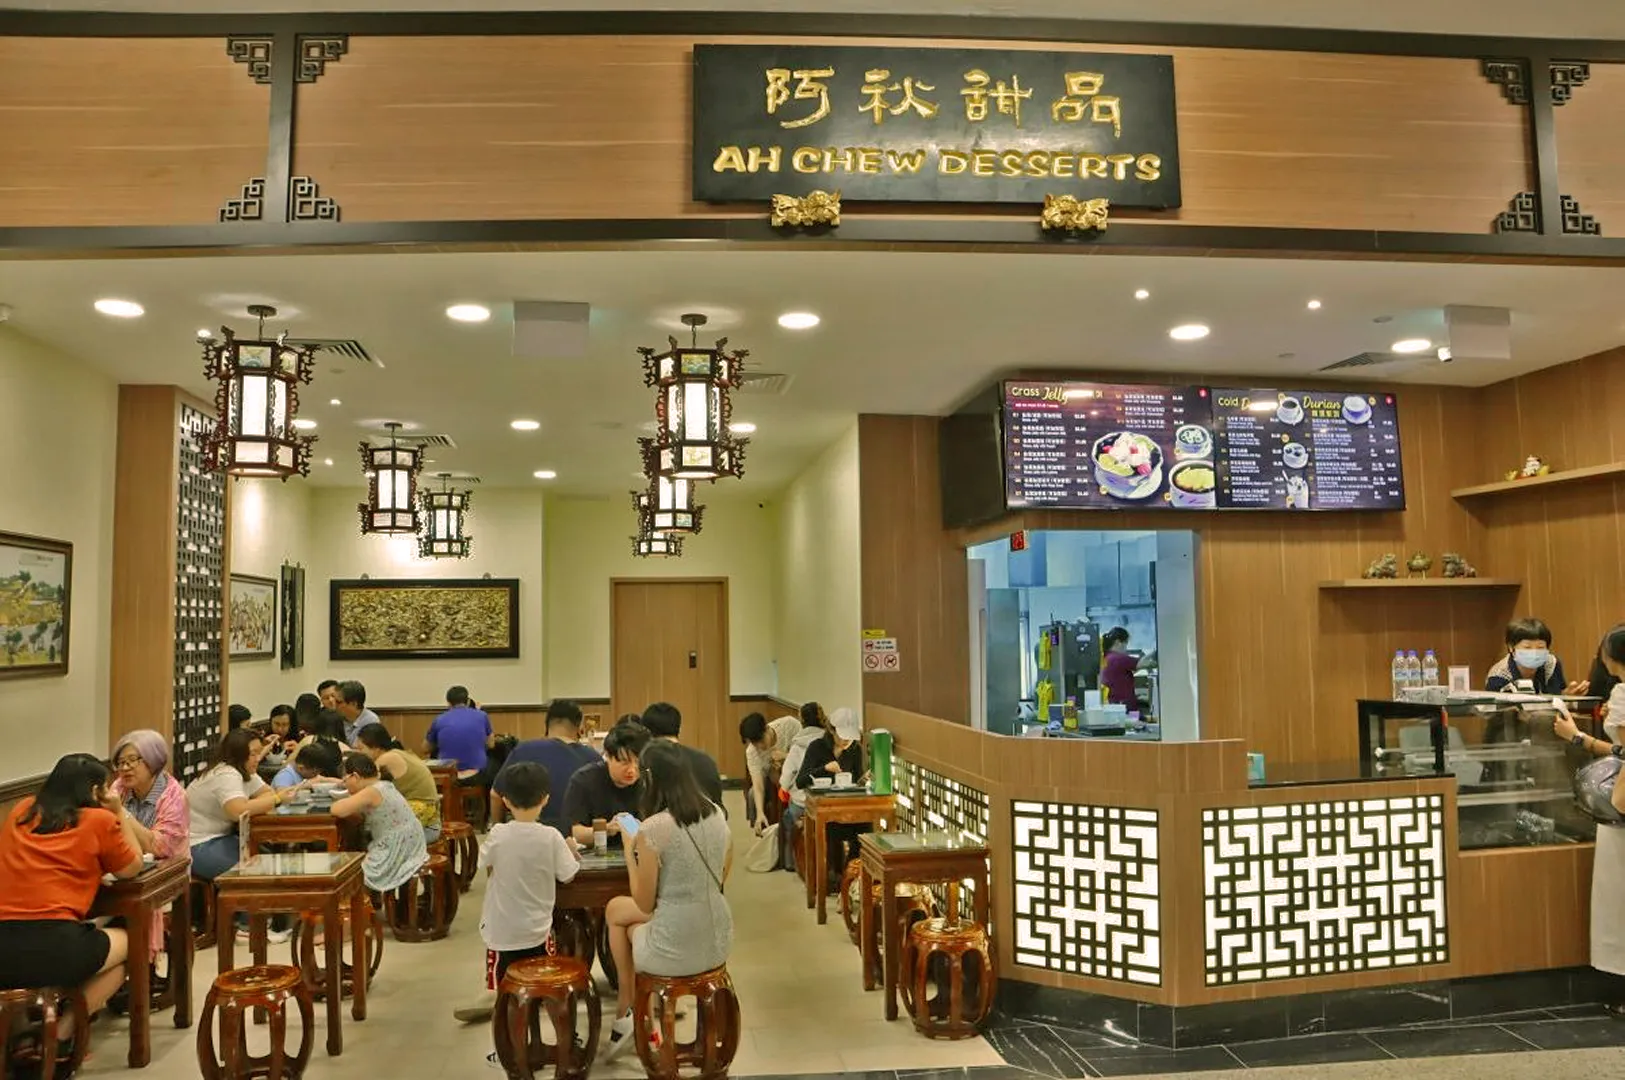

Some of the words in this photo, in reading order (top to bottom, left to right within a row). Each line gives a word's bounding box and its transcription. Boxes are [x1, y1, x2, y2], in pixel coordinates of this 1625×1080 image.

[713, 145, 782, 174] AH
[791, 146, 926, 176] CHEW
[937, 149, 1162, 182] DESSERTS
[1012, 386, 1040, 397] Grass
[1041, 387, 1069, 405] Jelly
[1218, 397, 1240, 407] Cold
[1302, 395, 1342, 410] Durian
